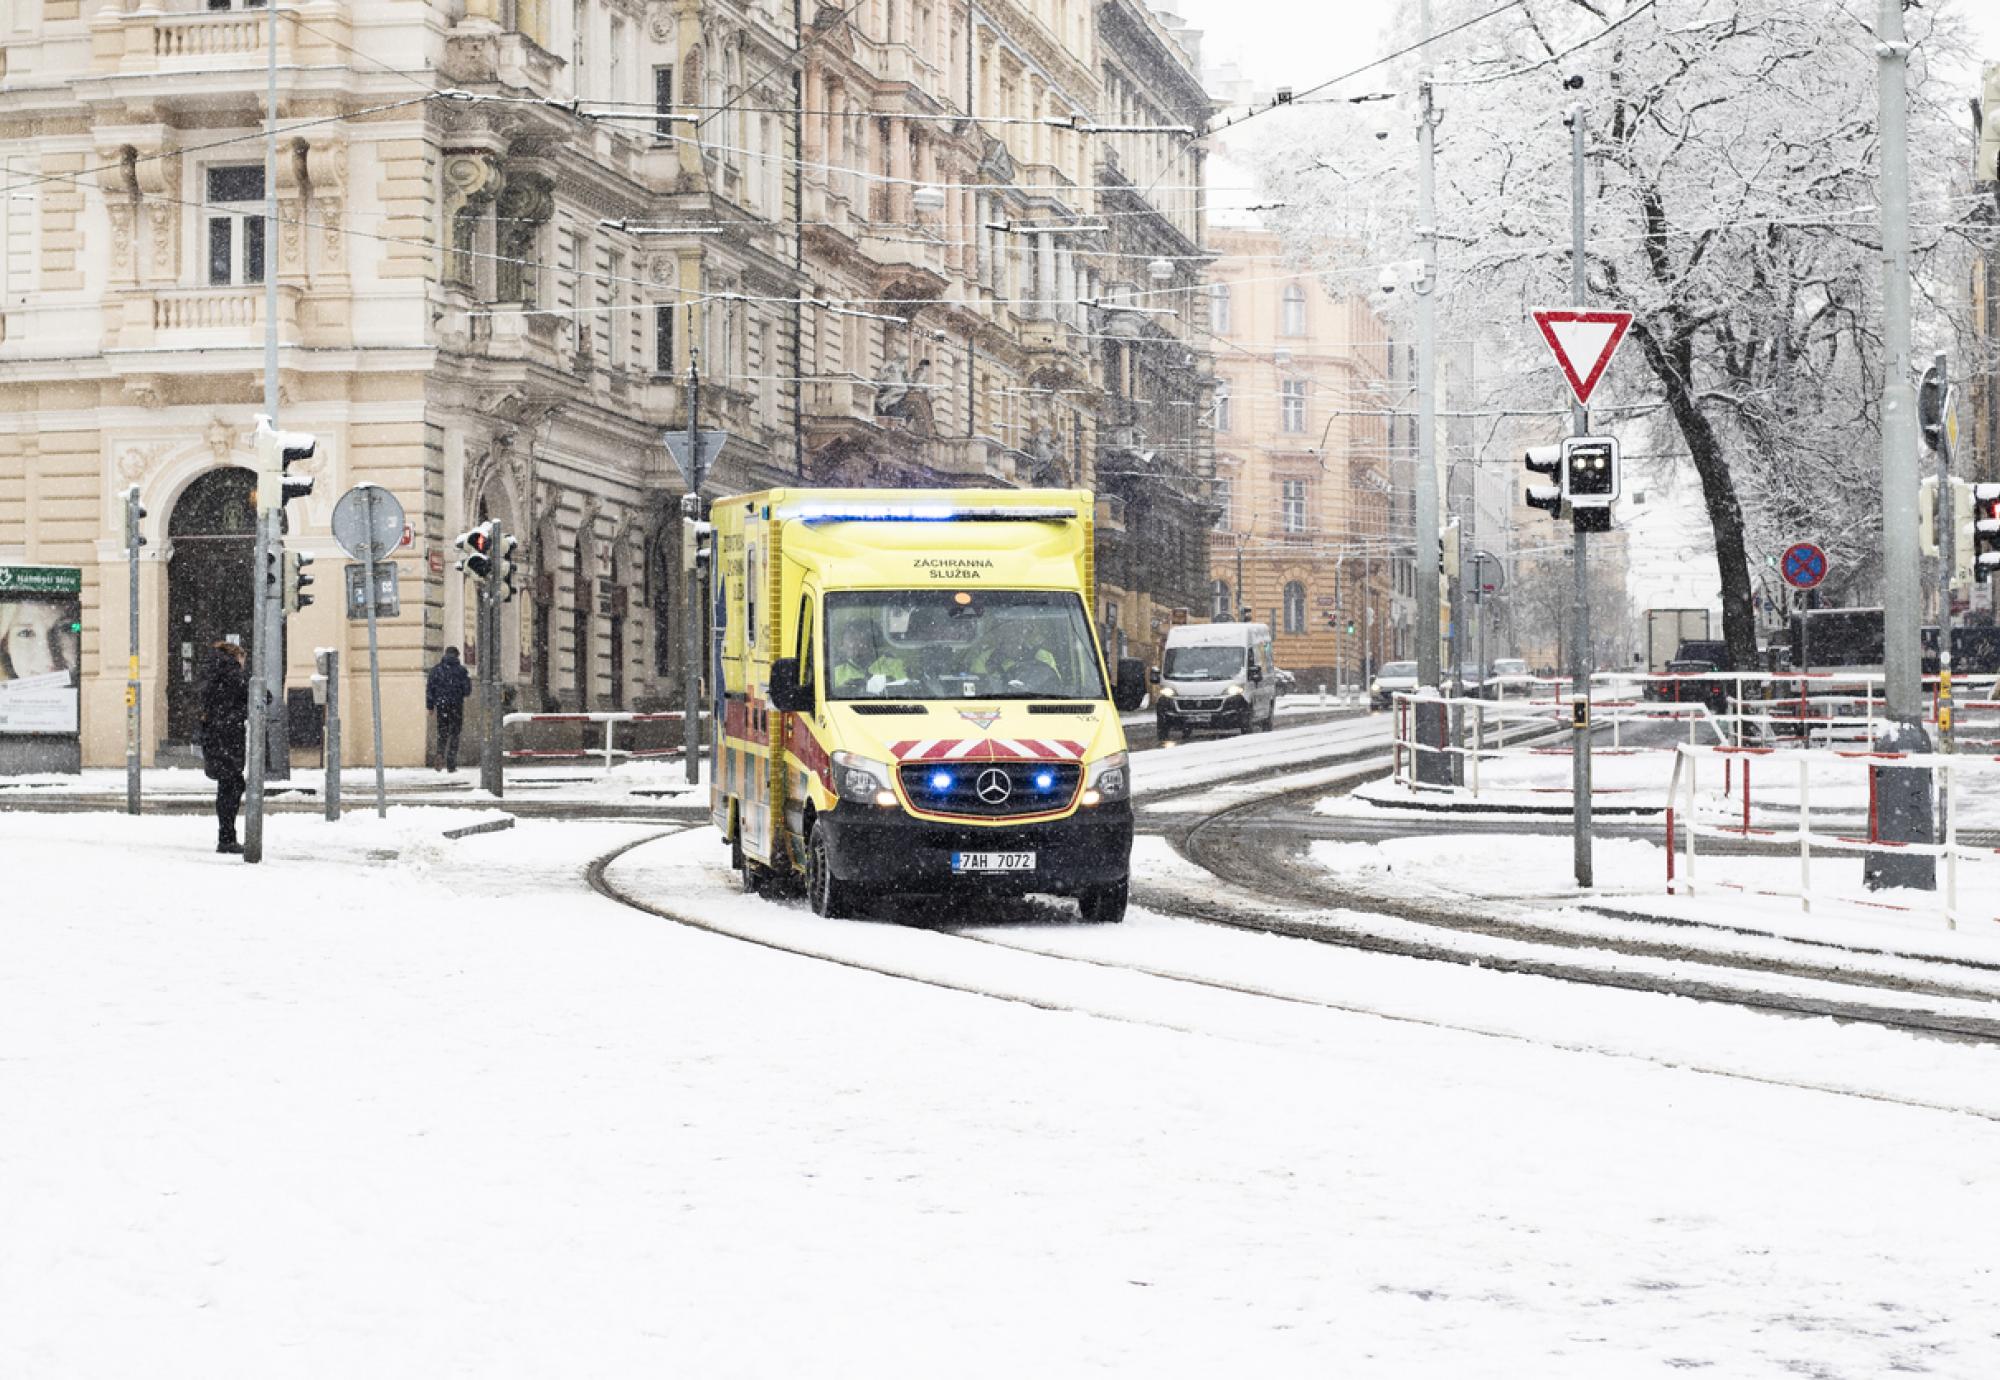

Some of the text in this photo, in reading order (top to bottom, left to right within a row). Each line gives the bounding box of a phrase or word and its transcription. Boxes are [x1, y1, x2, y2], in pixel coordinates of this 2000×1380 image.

[929, 568, 981, 579] SLUŽBA
[962, 854, 1031, 868] 7AH 7072
